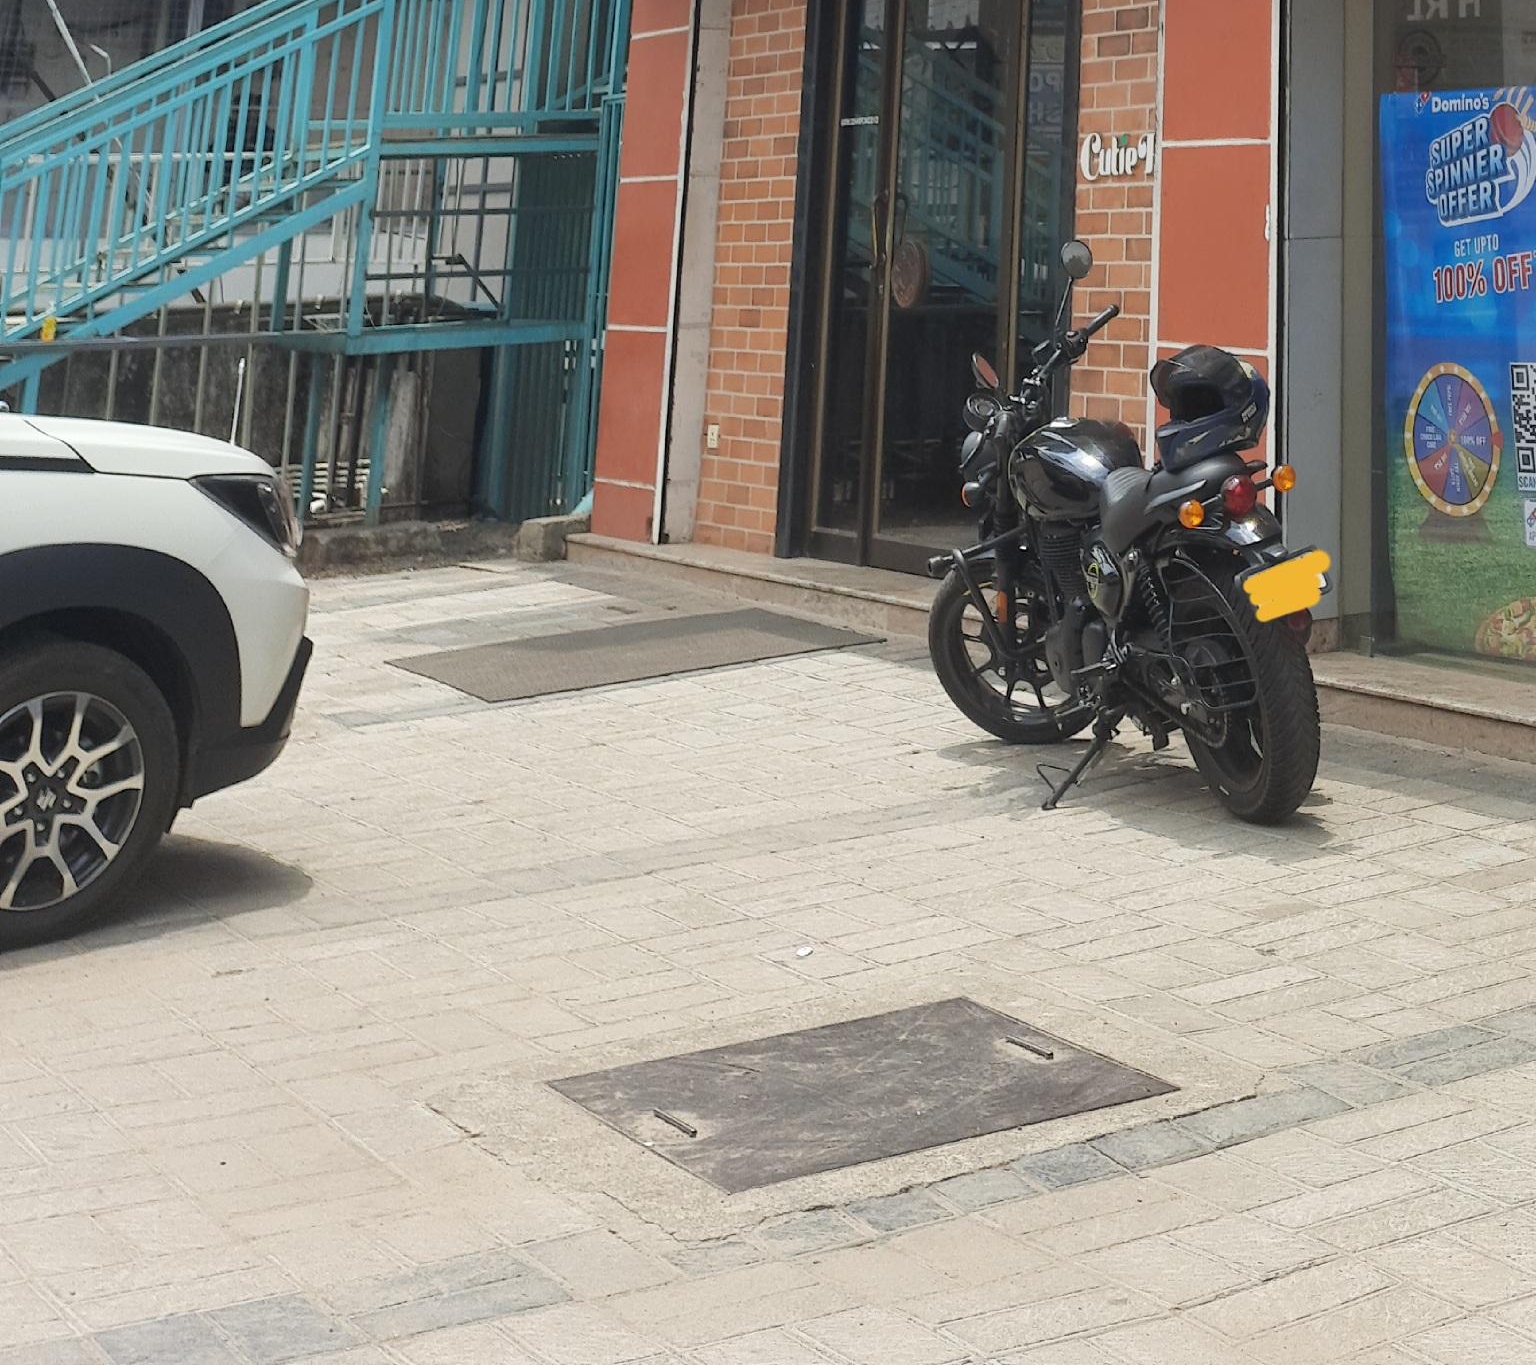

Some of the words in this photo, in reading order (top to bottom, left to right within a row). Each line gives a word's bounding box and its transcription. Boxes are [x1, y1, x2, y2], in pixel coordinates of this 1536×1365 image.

[1431, 91, 1490, 113] Domino's
[1430, 116, 1490, 166] SUPER
[1427, 144, 1506, 195] SPINNER
[1438, 180, 1496, 219] OFFER
[1454, 238, 1472, 258] GET
[1473, 233, 1499, 255] UPTO
[1433, 259, 1488, 304] 100%
